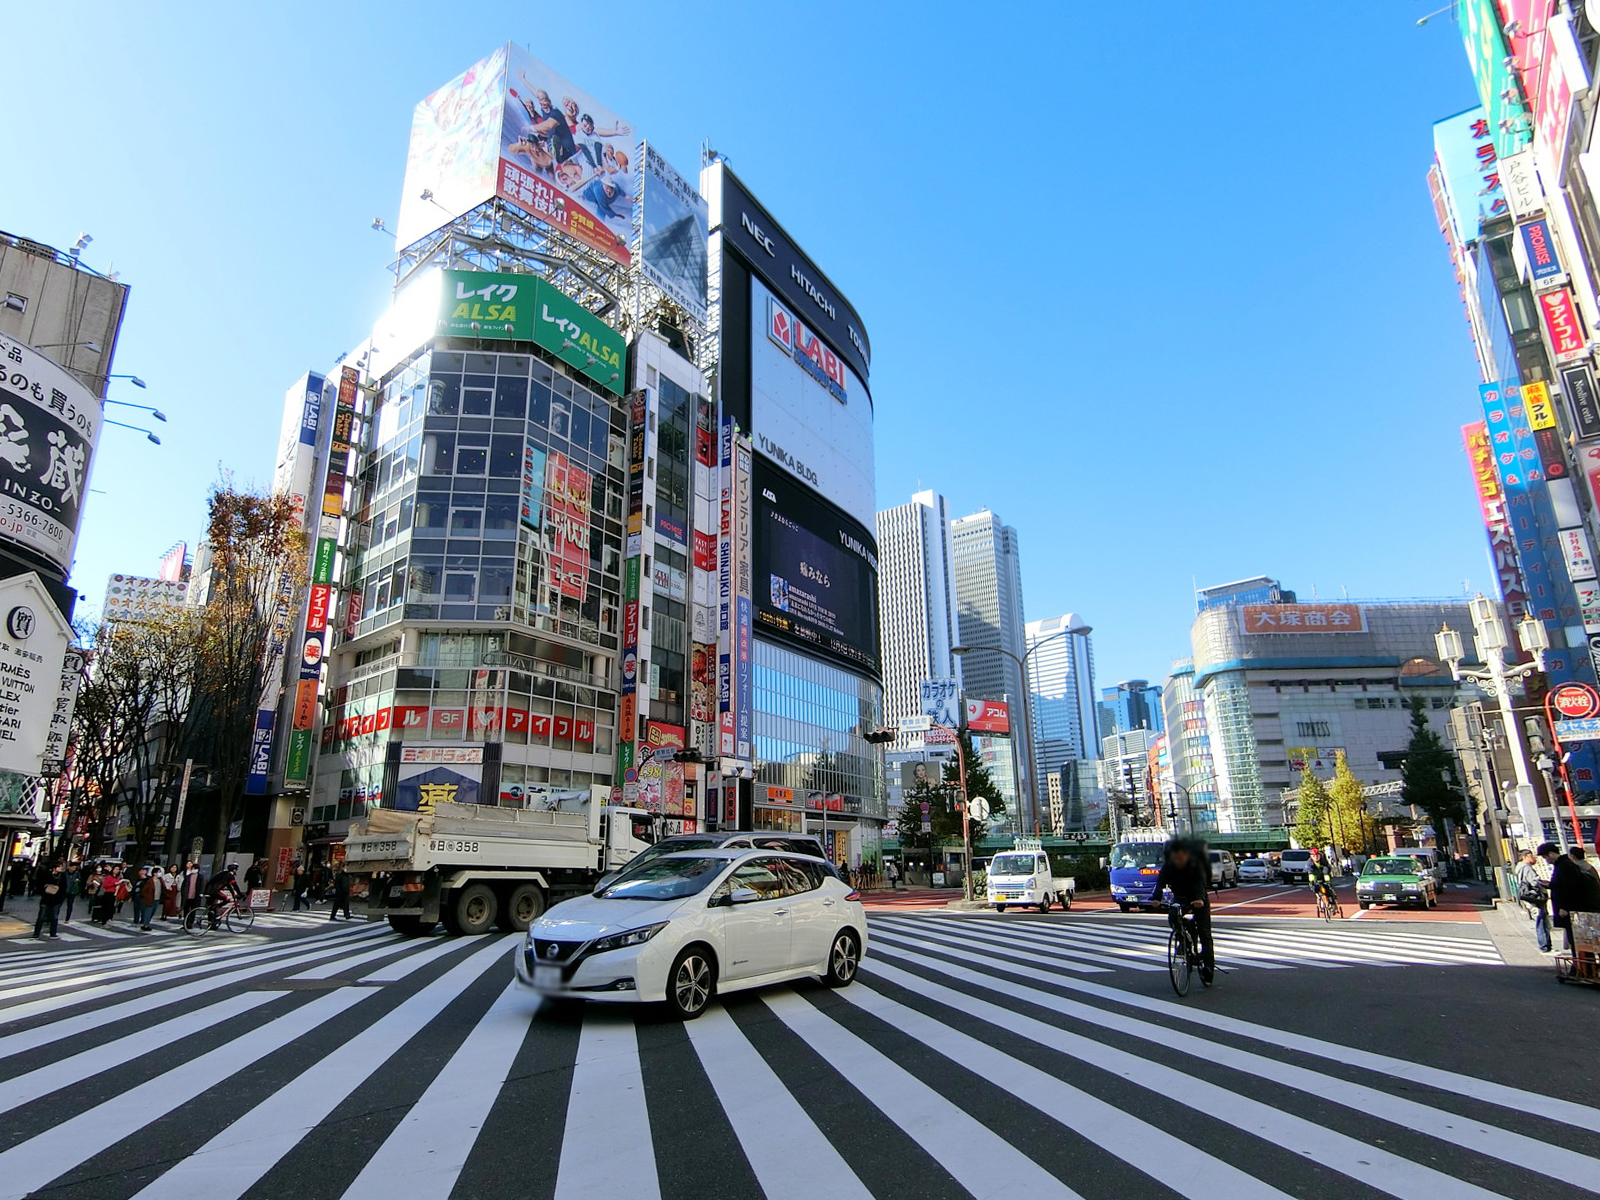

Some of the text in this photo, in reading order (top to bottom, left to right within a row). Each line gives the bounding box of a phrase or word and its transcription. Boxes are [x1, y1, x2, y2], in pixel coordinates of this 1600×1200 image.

[1508, 160, 1533, 208] 戸谷ビル
[740, 211, 776, 258] NEC
[1528, 224, 1551, 266] PROMISE
[456, 281, 518, 303] レイク
[790, 263, 836, 321] HITACHI
[452, 302, 517, 322] ALSA
[542, 303, 581, 340] レイク
[1549, 306, 1578, 351] アイフル
[579, 332, 620, 370] ALSA
[794, 319, 847, 388] LABI
[306, 402, 320, 431] LABI
[722, 435, 730, 464] LABI
[758, 432, 820, 488] YUNIKA BLDG.
[721, 498, 730, 537] LABI
[1469, 431, 1498, 497] パチンコ
[1486, 500, 1522, 595] エスパス
[838, 529, 867, 560] YUNIKA
[720, 541, 731, 598] SHINJUKU
[310, 586, 327, 629] アイフル
[1253, 609, 1353, 627] 大塚商会
[627, 603, 638, 644] アイフル
[305, 644, 321, 659] 薬
[0, 663, 31, 680] RMÈS
[625, 660, 636, 673] 薬
[2, 676, 36, 694] VUITTON
[721, 676, 729, 703] LABI
[922, 681, 956, 699] カラオケ
[935, 699, 945, 711] の
[985, 707, 1006, 718] アコム
[1559, 696, 1589, 708] 消火栓
[440, 711, 459, 724] 3F
[511, 711, 592, 740] アイフル
[256, 744, 270, 775] LABI
[685, 821, 694, 830] 24
